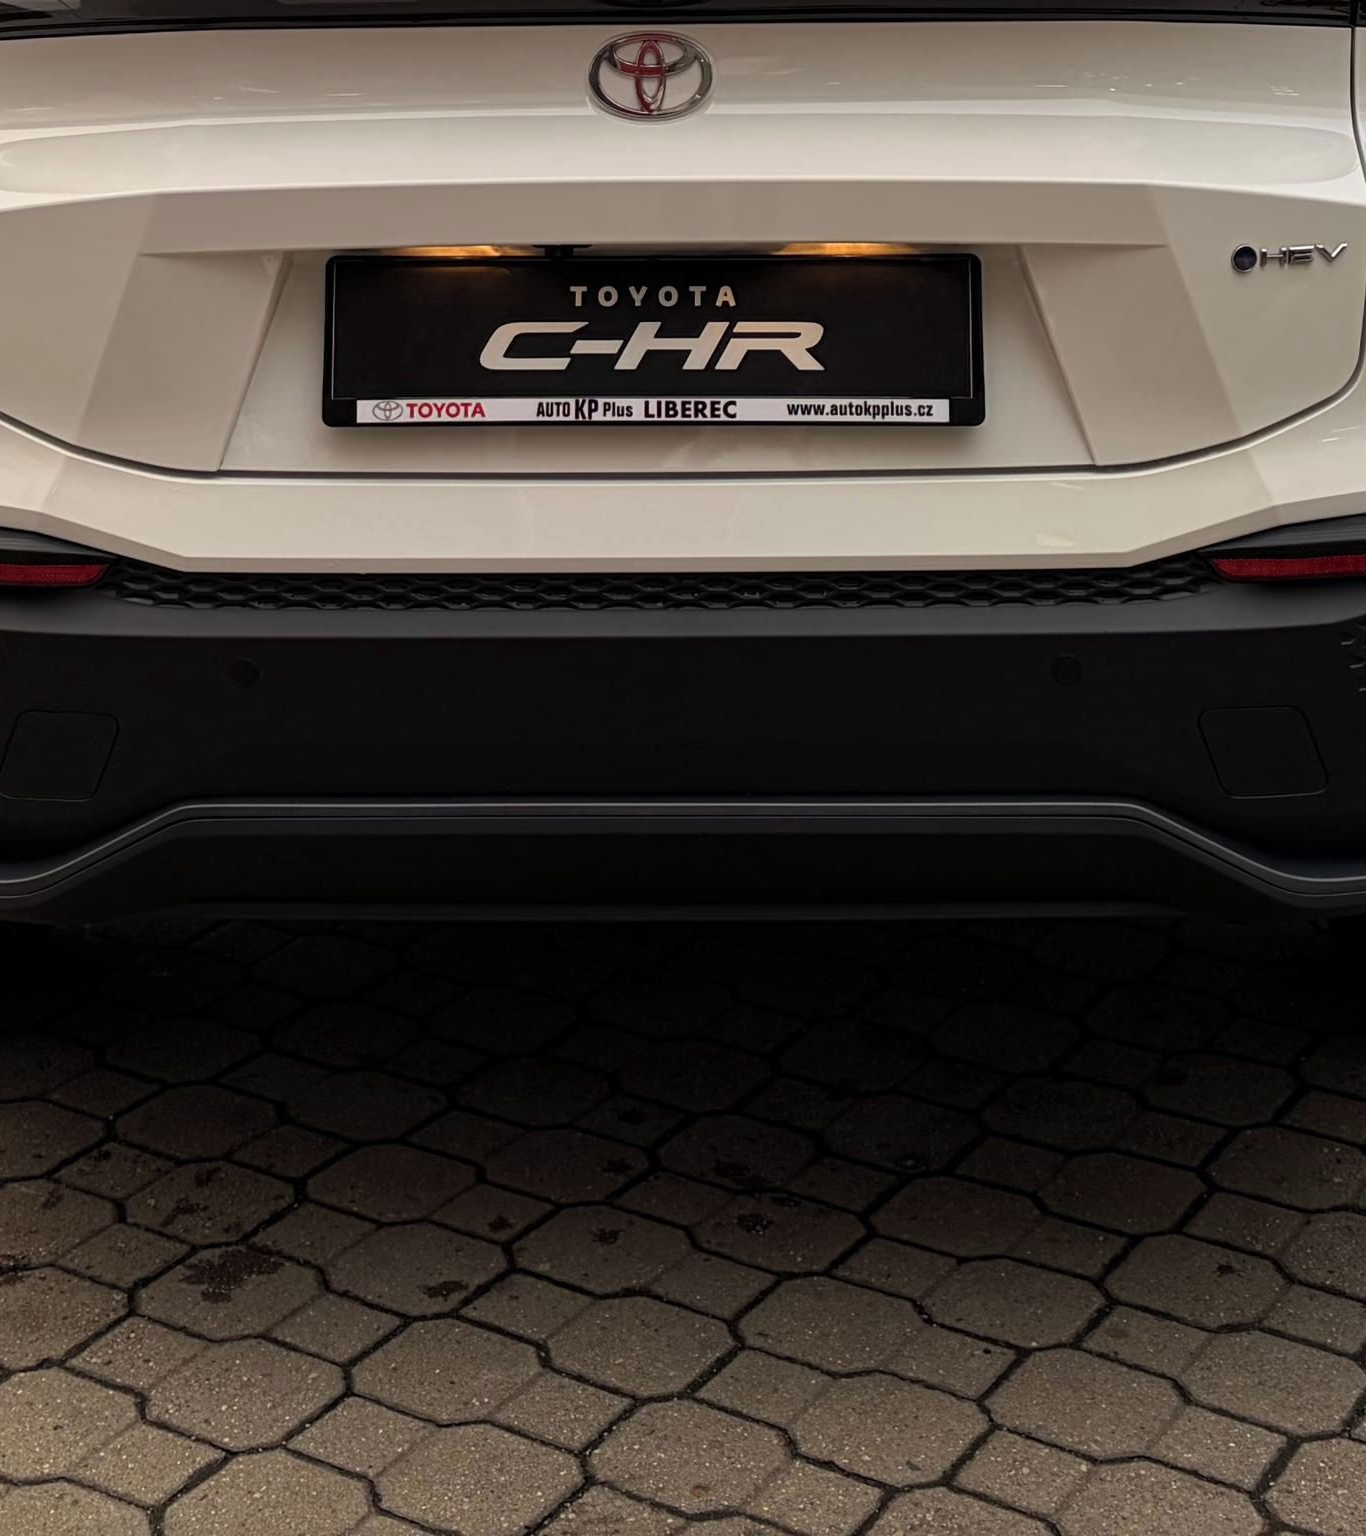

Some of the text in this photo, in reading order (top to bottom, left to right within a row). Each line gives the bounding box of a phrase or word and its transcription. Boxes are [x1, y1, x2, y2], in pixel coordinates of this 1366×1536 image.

[1259, 243, 1347, 268] HEV
[570, 285, 736, 307] TOYOTA
[479, 321, 825, 371] C-HR
[406, 399, 934, 420] TOYOTA AUTO KP Plus LIBEREC www.autokpplus.cz
